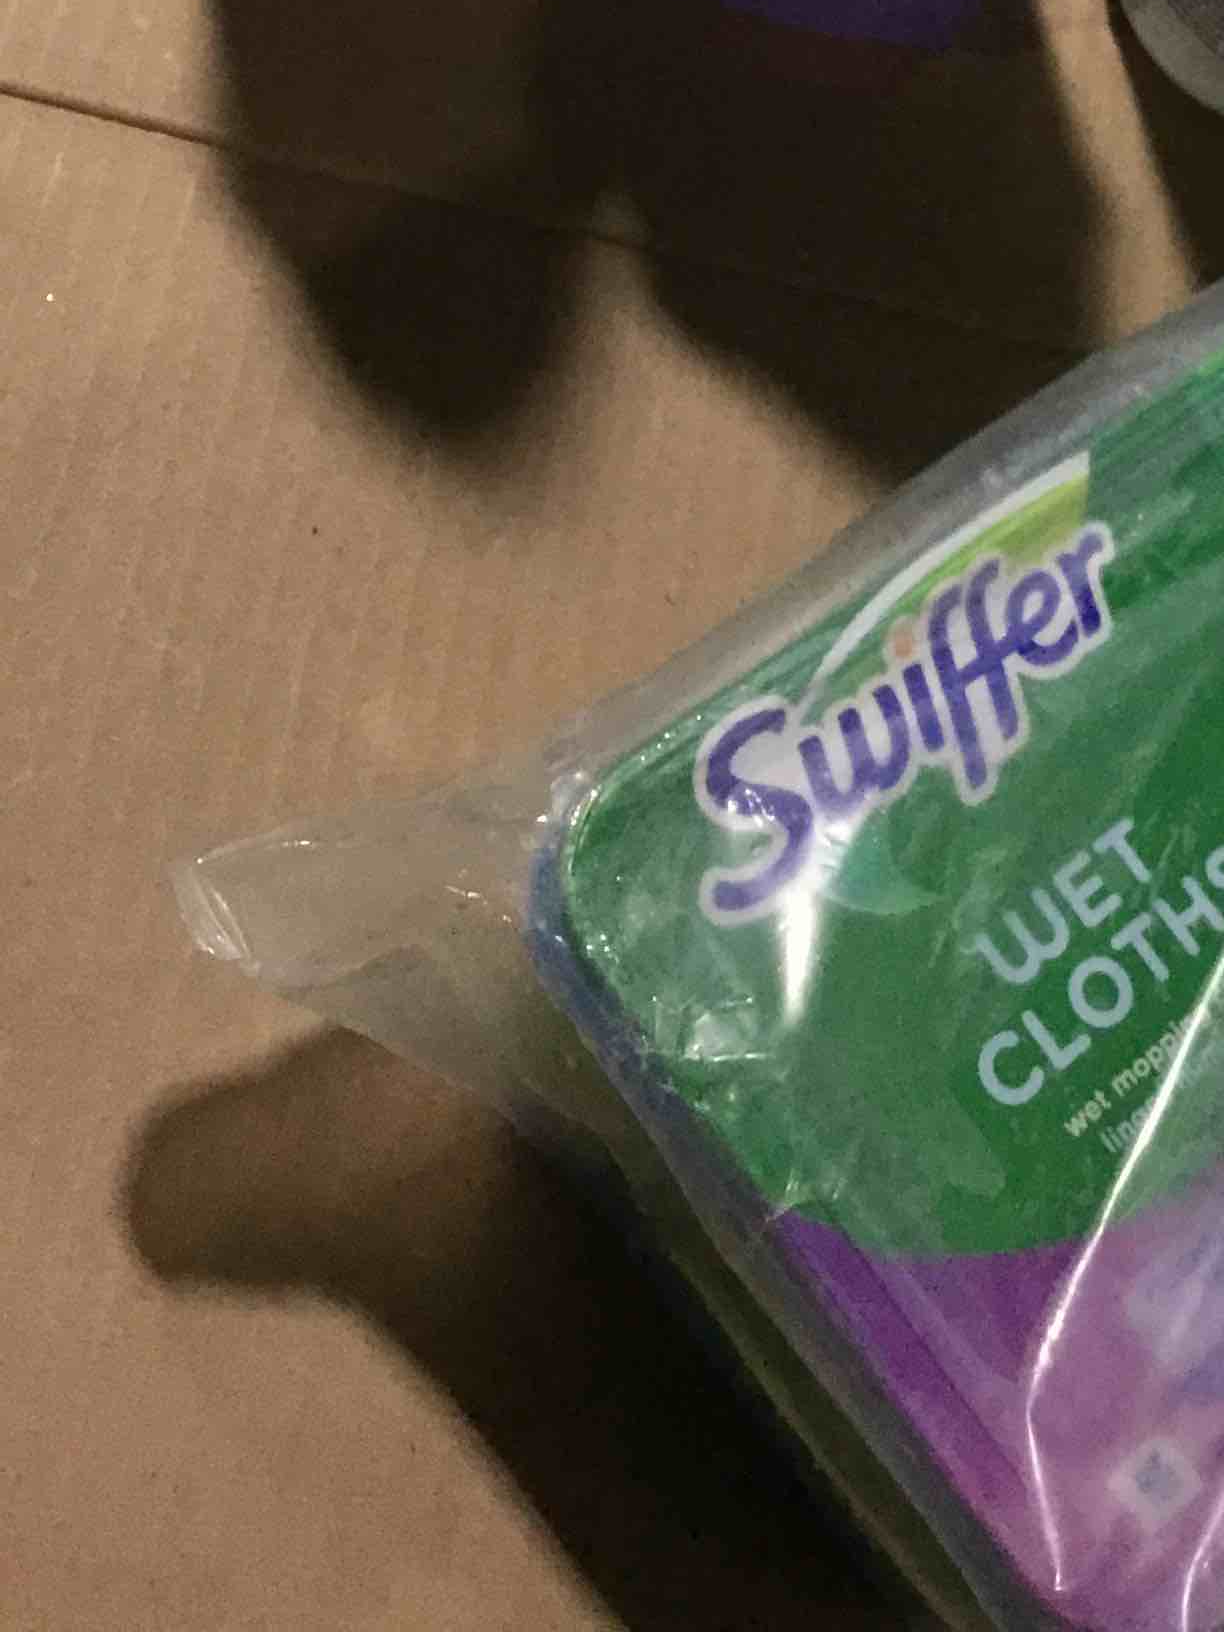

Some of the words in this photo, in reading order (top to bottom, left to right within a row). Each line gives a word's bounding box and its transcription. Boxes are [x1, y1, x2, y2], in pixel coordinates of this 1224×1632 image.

[698, 525, 1109, 918] Swiffer
[975, 818, 1151, 984] WET
[1064, 1089, 1112, 1137] wet
